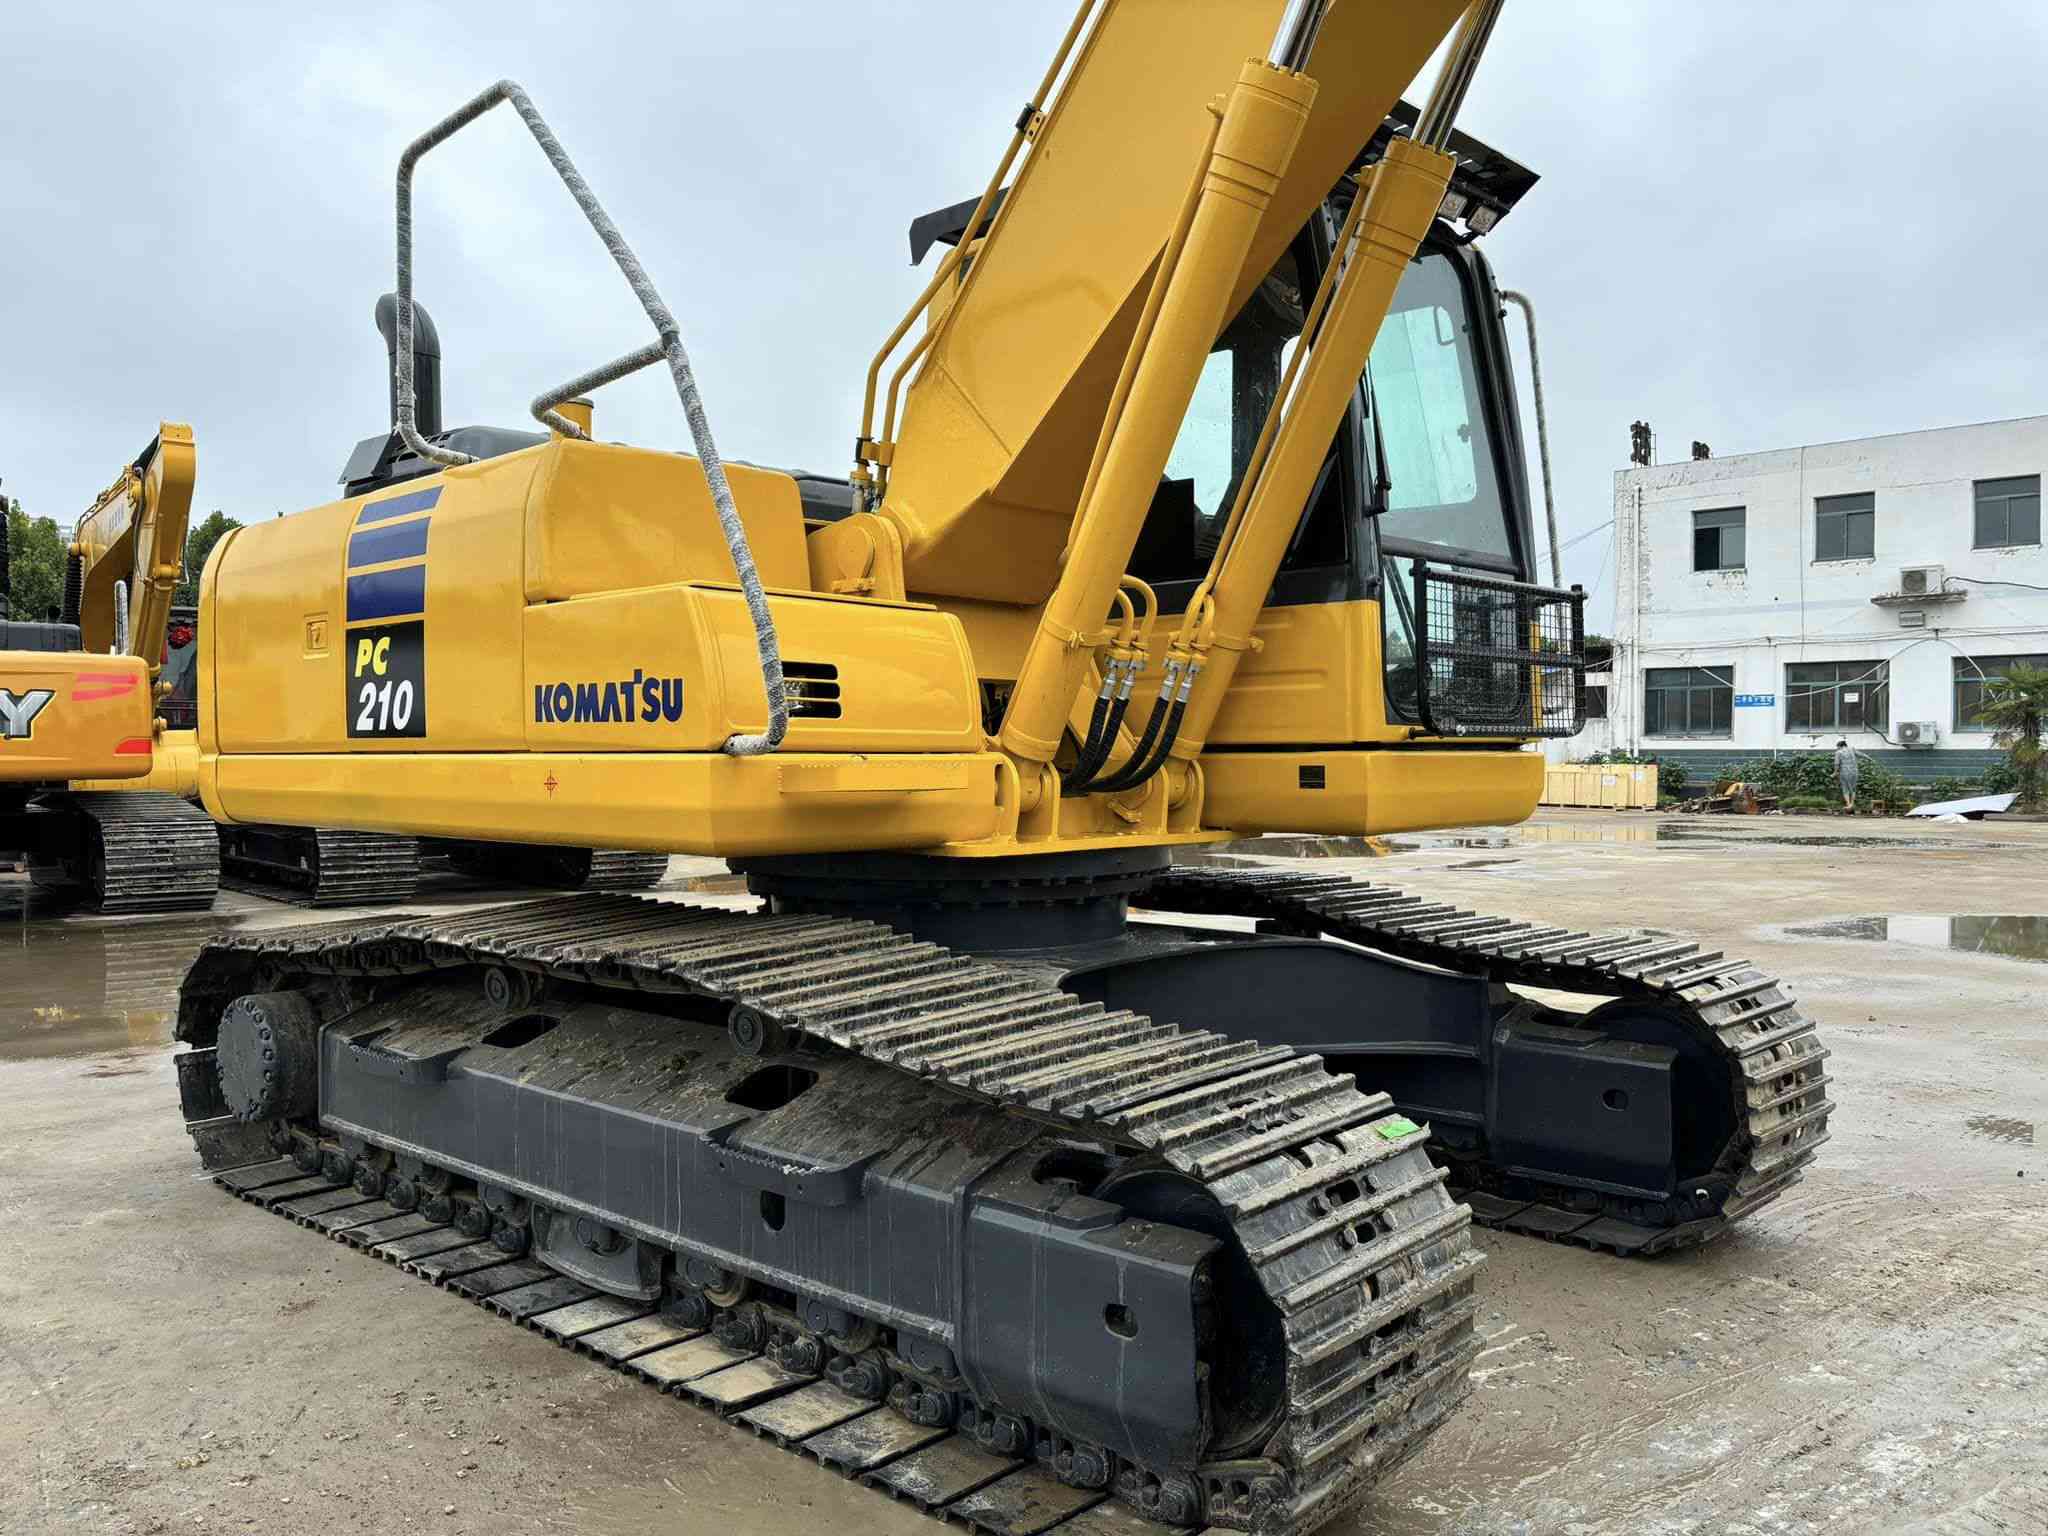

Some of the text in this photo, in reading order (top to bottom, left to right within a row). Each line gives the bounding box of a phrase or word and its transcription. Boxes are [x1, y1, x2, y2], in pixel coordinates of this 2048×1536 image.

[354, 636, 391, 677] PC
[355, 679, 414, 731] 210
[534, 668, 683, 723] KOMATSU
